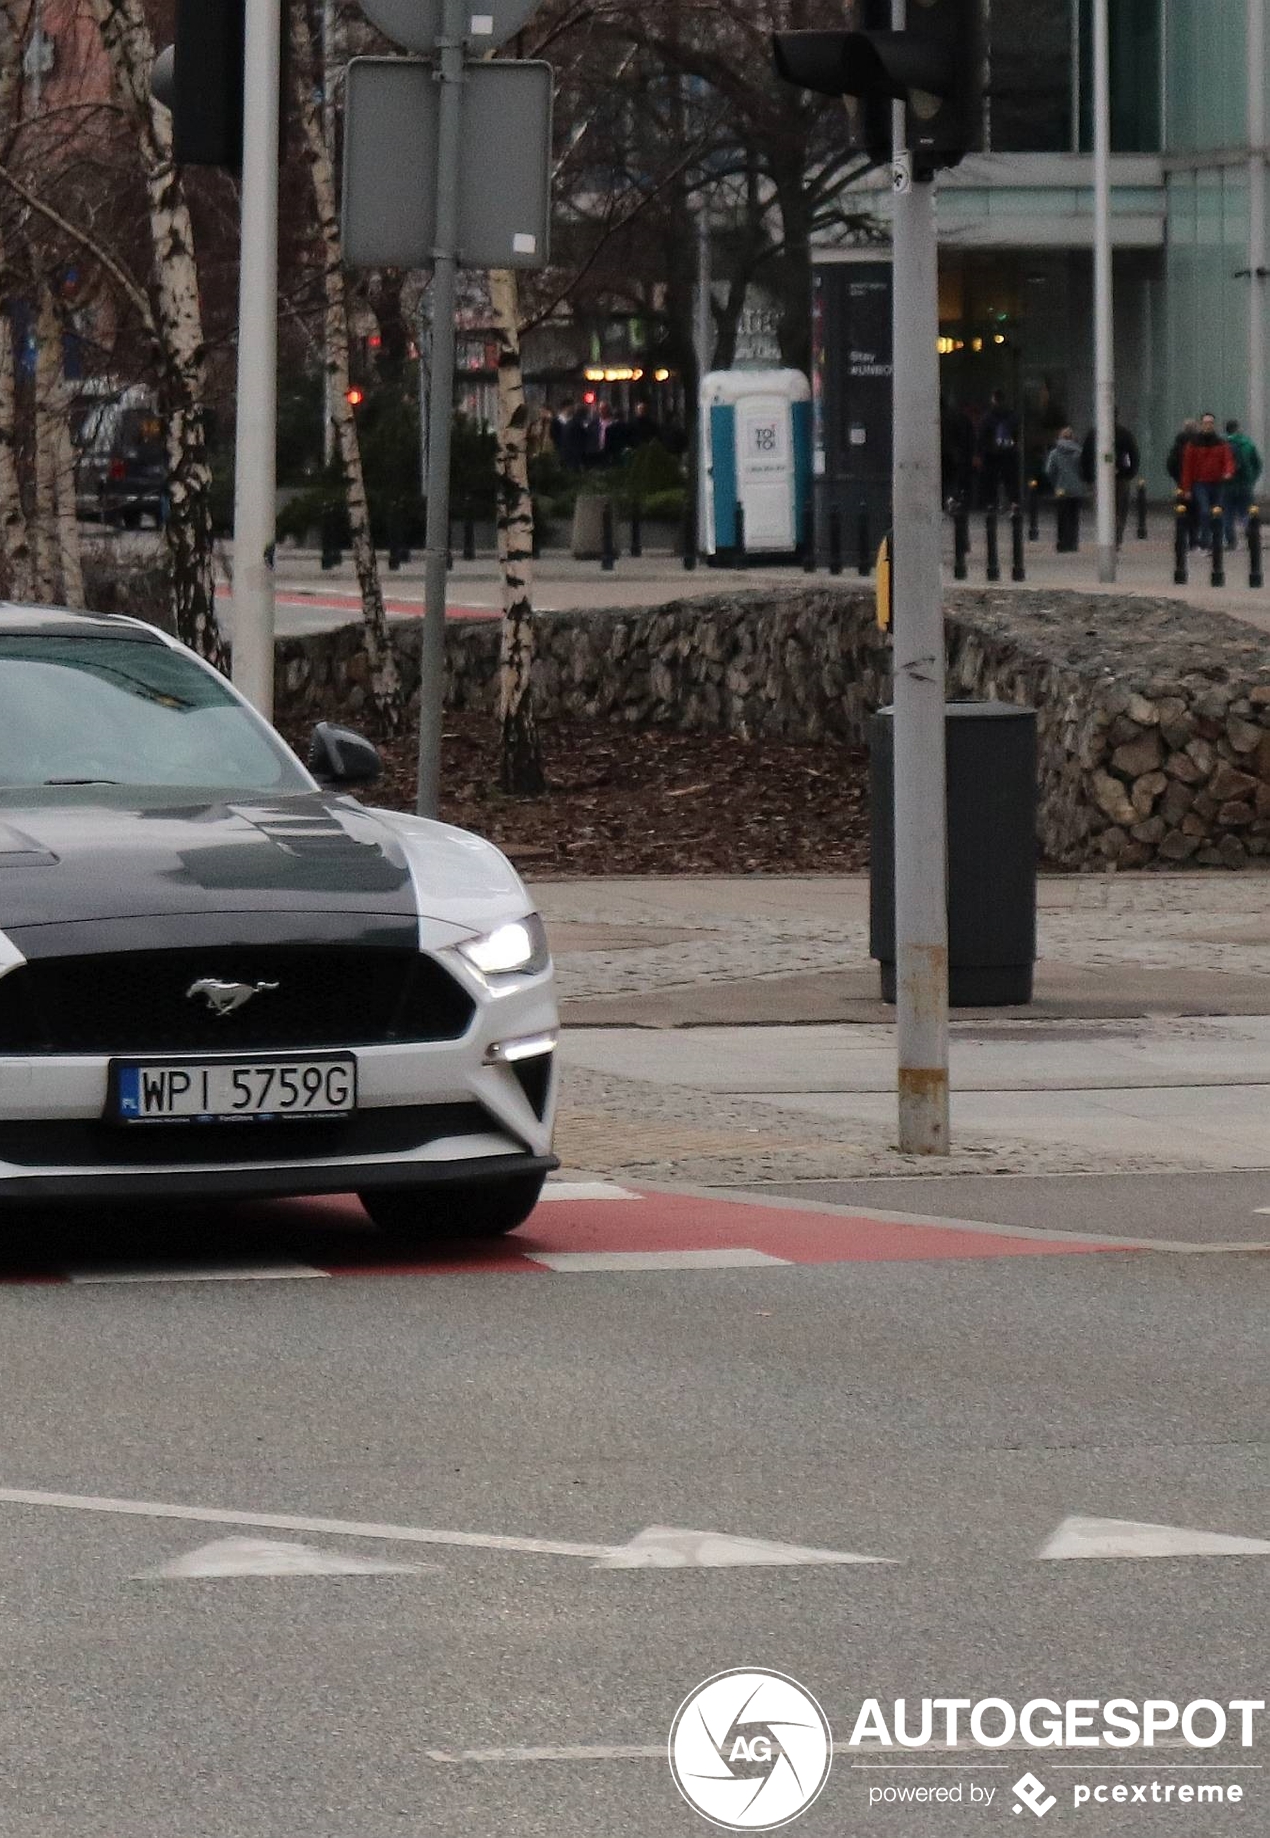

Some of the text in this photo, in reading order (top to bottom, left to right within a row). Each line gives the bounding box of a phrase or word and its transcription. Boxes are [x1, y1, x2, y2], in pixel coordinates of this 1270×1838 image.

[143, 1066, 348, 1112] WPI 5759G
[122, 1098, 137, 1109] PL
